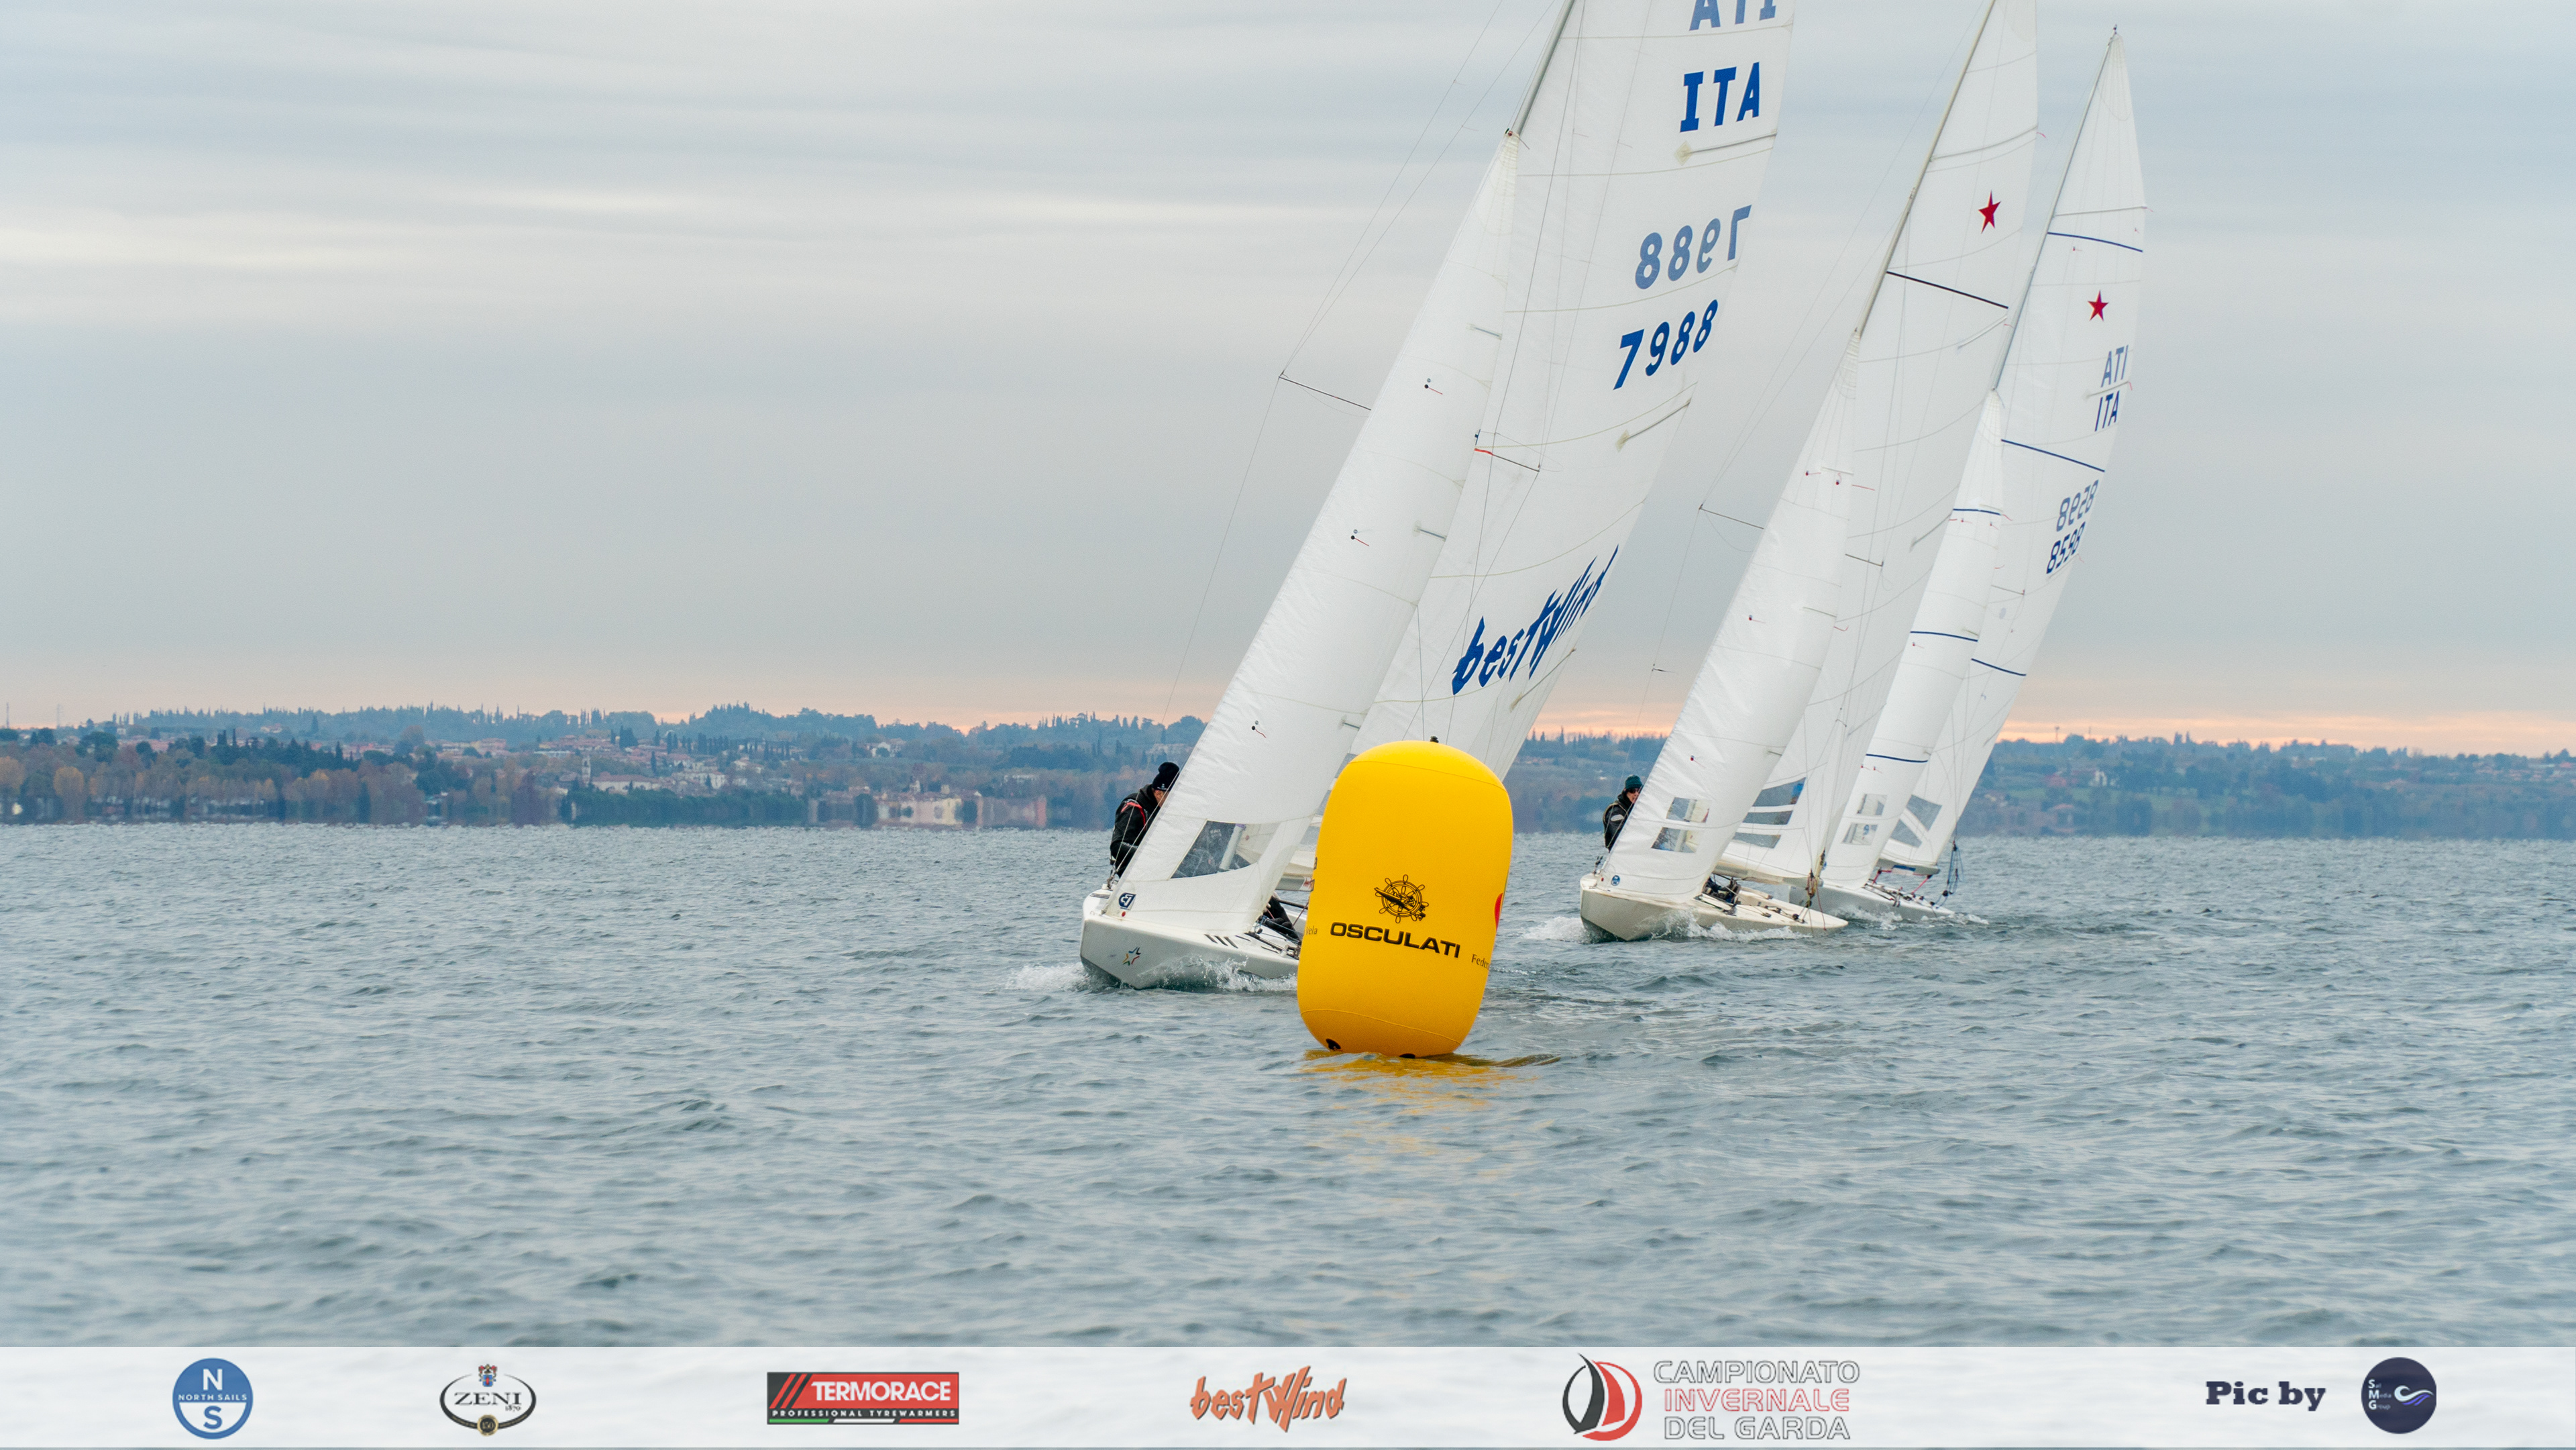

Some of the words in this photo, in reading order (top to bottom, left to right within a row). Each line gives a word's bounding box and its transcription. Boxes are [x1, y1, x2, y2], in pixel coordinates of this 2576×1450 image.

[1680, 62, 1760, 132] ITA
[1613, 299, 1718, 391] 7988
[2094, 390, 2120, 431] ITA
[2046, 521, 2086, 574] 8598
[1330, 921, 1461, 958] OSCULATI
